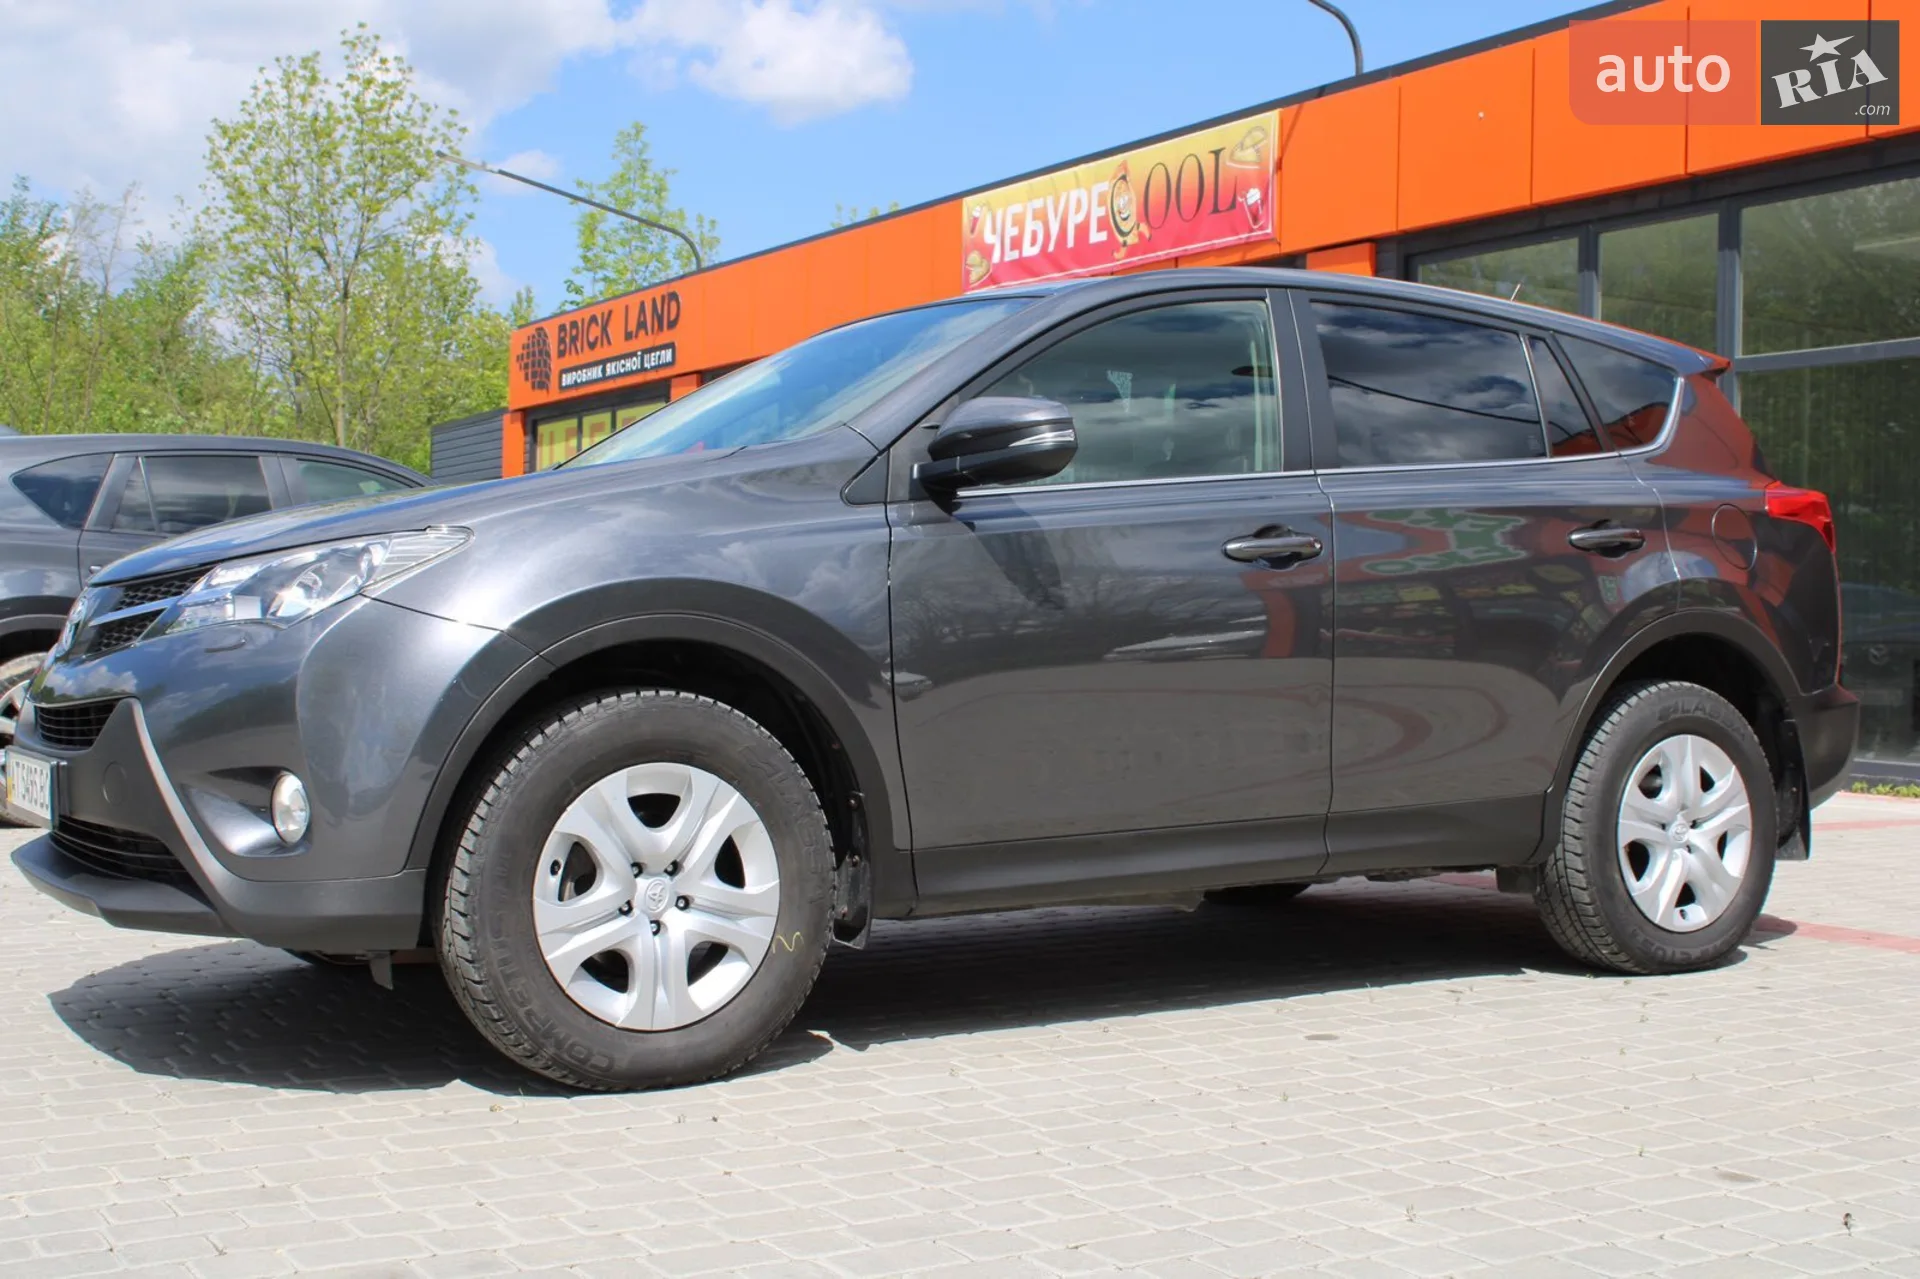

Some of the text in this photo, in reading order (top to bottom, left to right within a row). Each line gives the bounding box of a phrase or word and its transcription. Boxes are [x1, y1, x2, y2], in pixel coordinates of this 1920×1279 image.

[557, 291, 681, 359] BRICK LAND
[561, 348, 673, 387] ВИРОБНИК ЯКІСНОЇ ЦЕГЛИ
